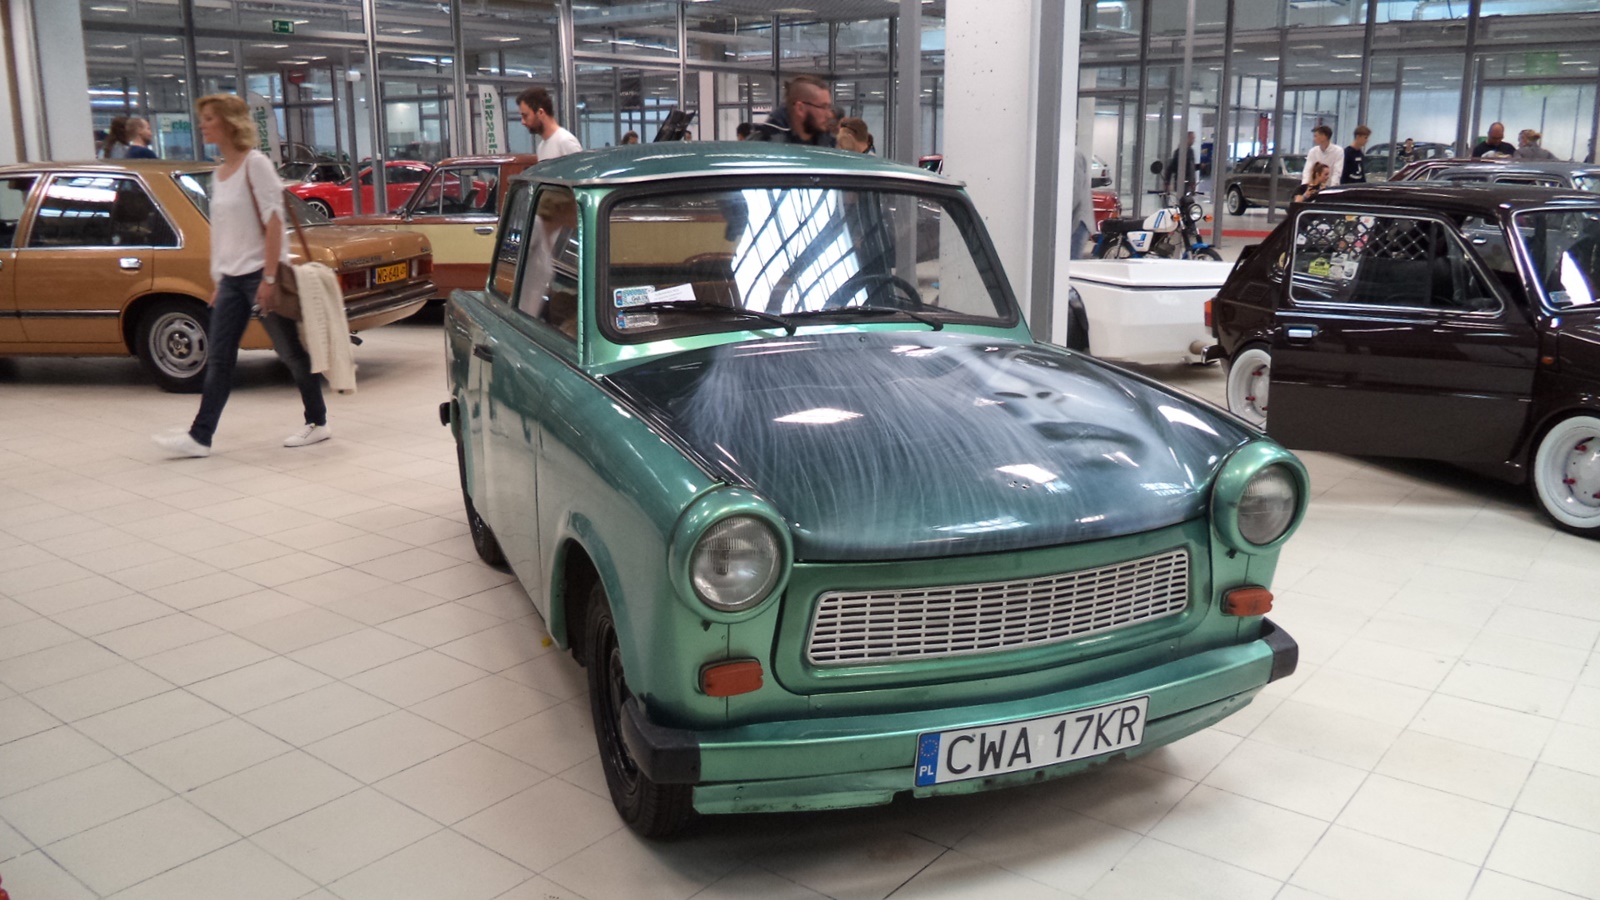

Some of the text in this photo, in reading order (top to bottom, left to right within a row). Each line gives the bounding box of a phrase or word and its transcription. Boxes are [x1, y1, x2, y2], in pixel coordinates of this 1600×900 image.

[946, 705, 1140, 774] CWA 17KR
[919, 765, 934, 777] PL
